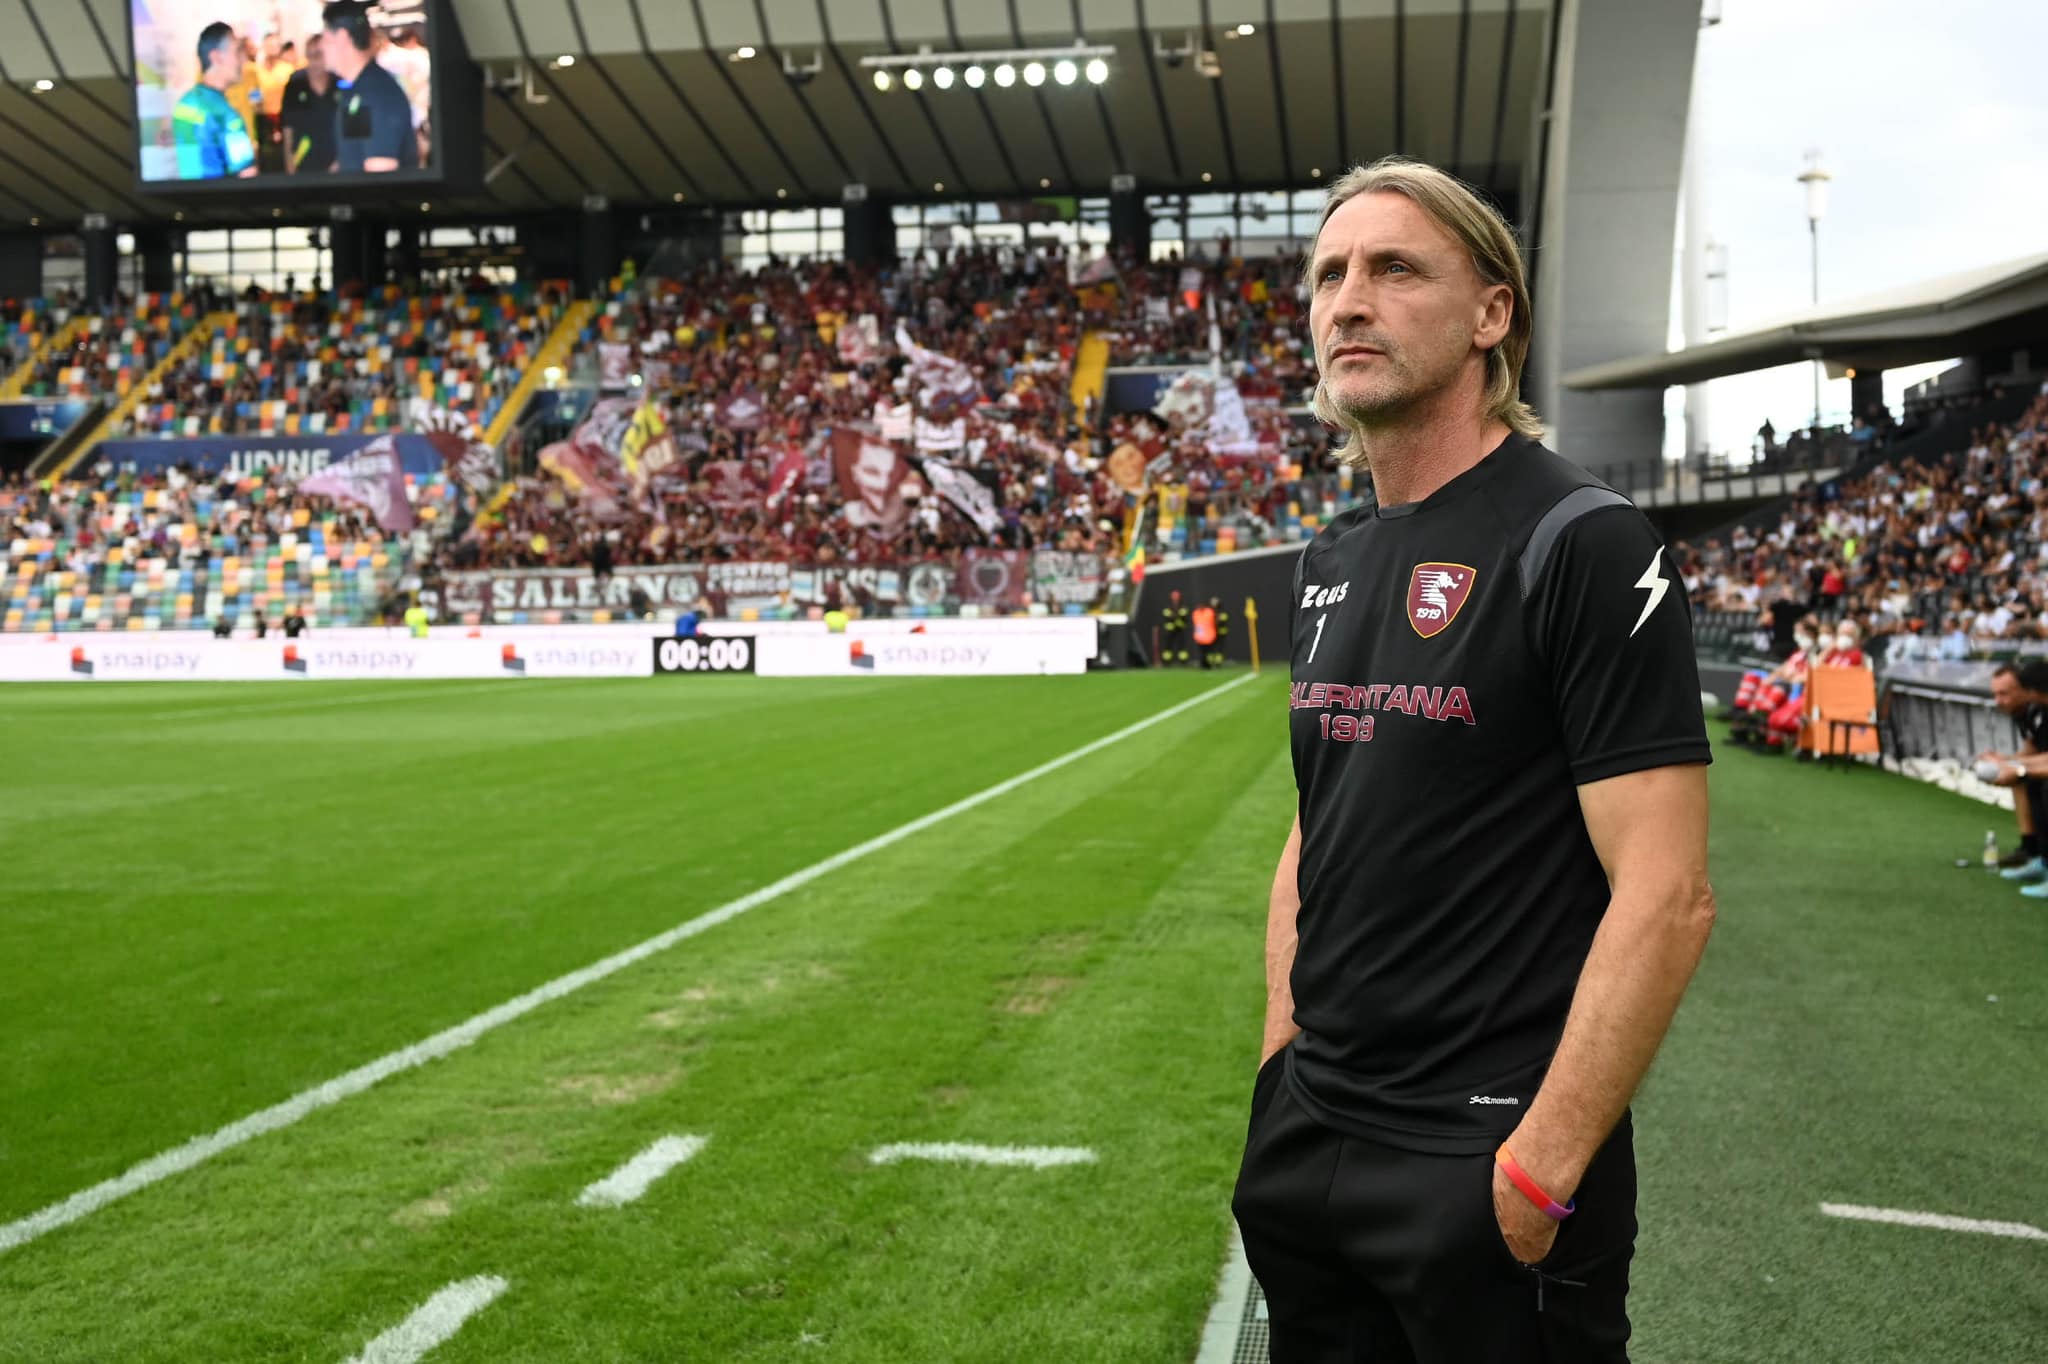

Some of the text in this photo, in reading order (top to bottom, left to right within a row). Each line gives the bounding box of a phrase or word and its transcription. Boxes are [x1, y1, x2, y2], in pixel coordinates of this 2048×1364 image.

[1301, 582, 1349, 608] Zeus
[1416, 608, 1441, 619] 1919
[102, 651, 200, 672] snaipay
[316, 649, 417, 671] snaipay
[534, 648, 637, 669] snaipay
[659, 638, 749, 671] 00:00
[883, 645, 991, 667] snaipay
